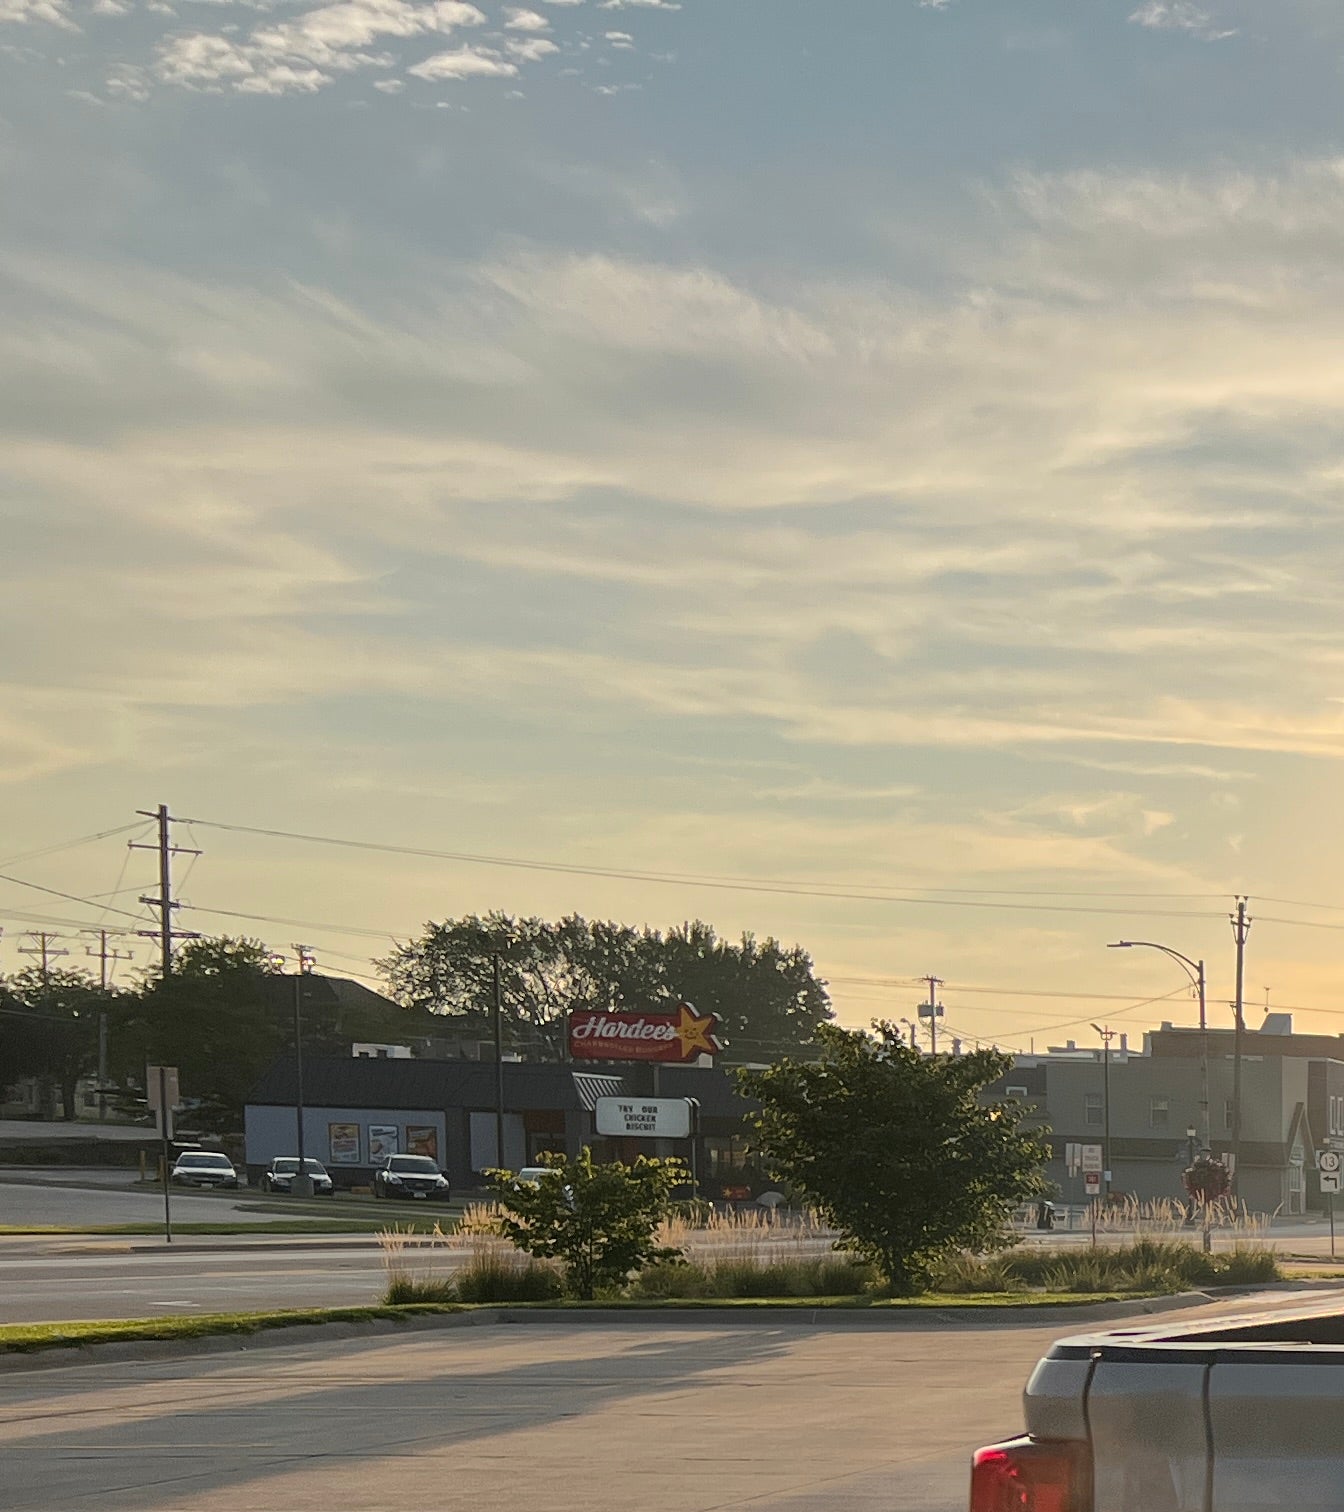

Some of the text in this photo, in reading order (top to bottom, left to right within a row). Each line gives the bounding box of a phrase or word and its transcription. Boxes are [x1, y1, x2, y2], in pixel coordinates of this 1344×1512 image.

[572, 1016, 678, 1041] Hardee's
[618, 1105, 658, 1114] TRY OUR
[624, 1114, 657, 1122] CHICKEN
[626, 1123, 656, 1131] BISCUIT
[1325, 1156, 1335, 1168] 13
